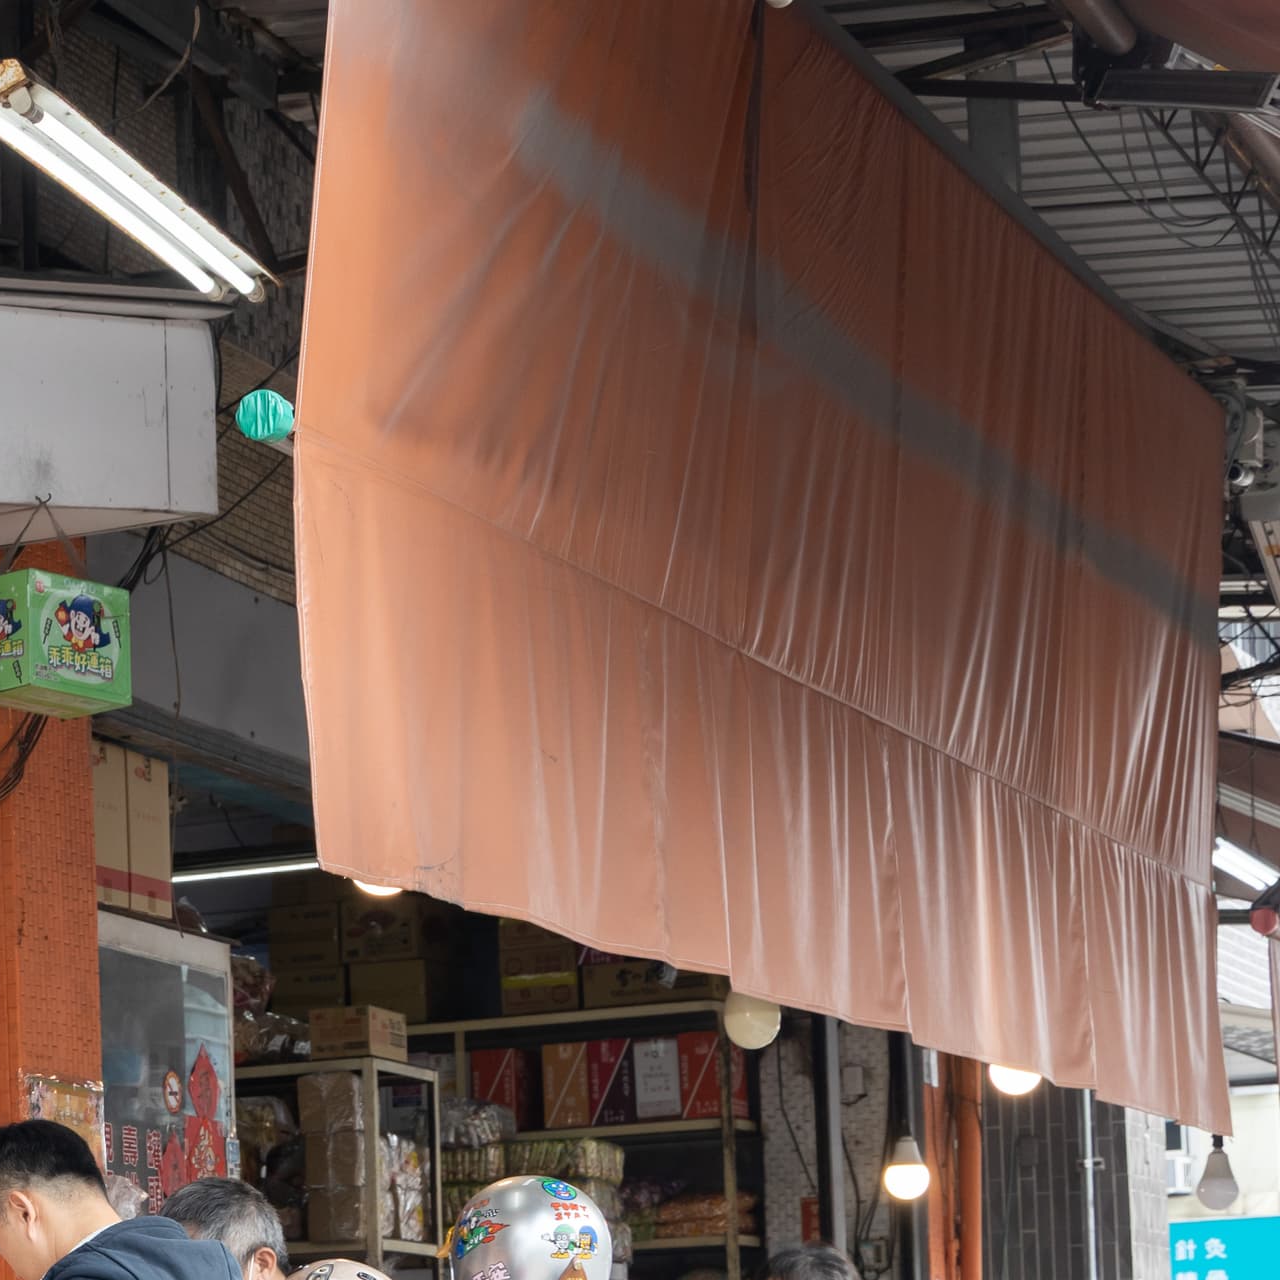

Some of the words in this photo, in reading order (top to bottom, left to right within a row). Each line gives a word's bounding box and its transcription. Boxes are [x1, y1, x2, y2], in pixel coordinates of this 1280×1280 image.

[48, 646, 113, 680] 乖乖好運箱
